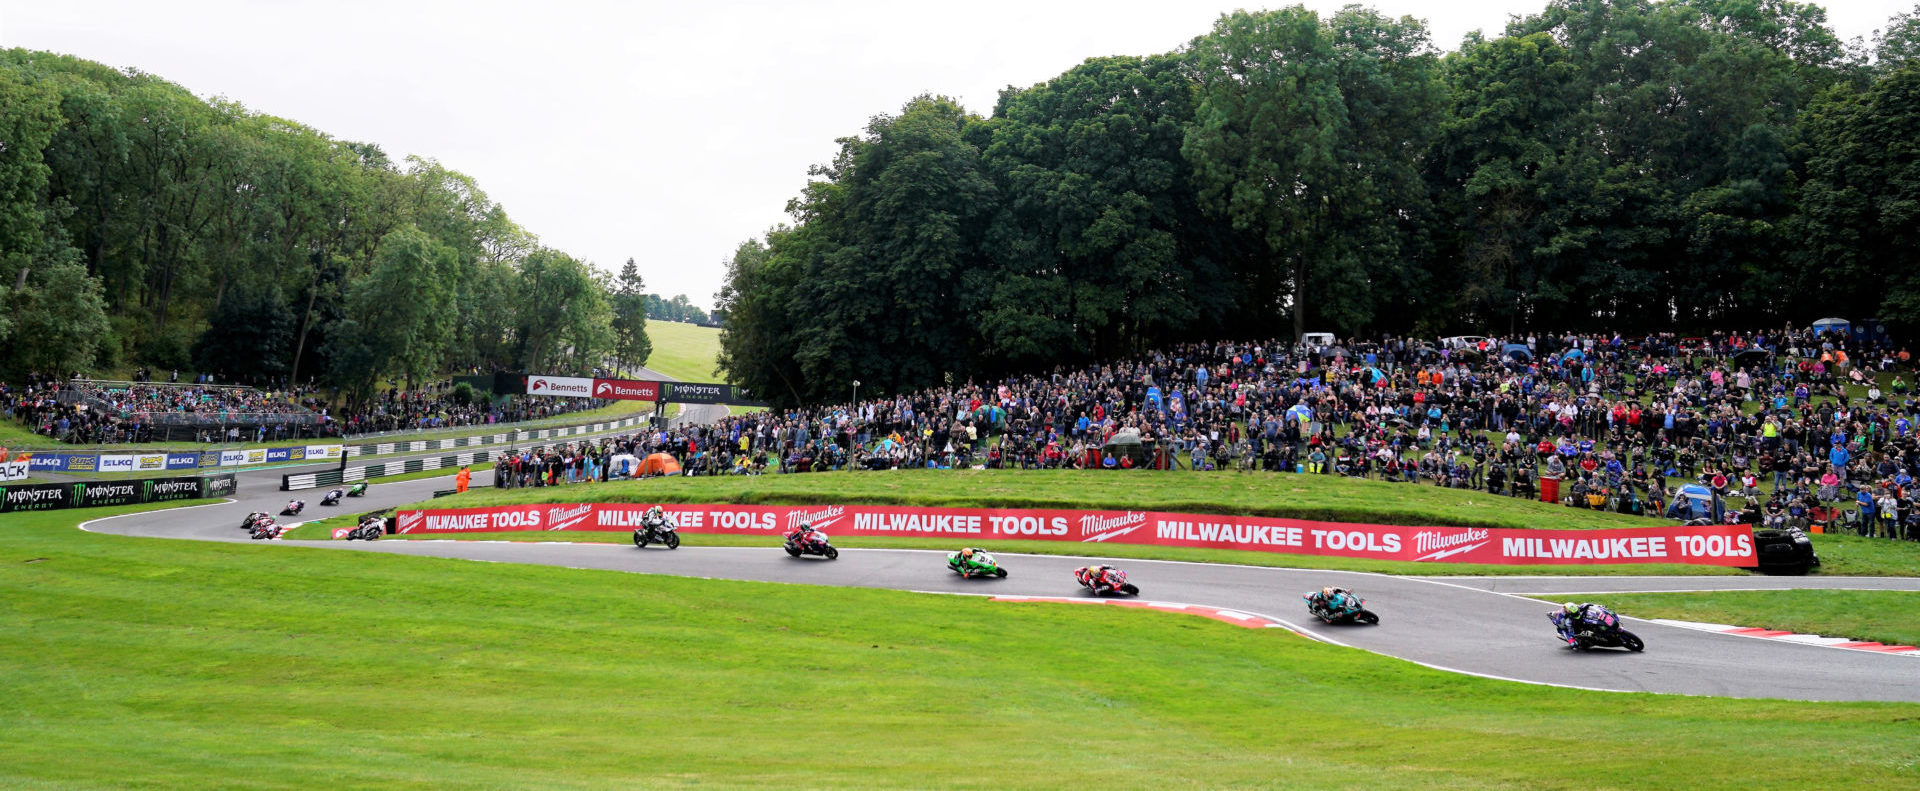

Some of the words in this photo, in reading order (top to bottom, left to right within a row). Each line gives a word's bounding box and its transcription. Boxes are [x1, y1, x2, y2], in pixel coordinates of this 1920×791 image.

[551, 383, 588, 393] Bennetts
[615, 386, 654, 396] Bennetts
[674, 385, 720, 395] MONSTER
[36, 458, 61, 466] LKQ
[7, 488, 62, 503] MONSTER
[86, 484, 135, 499] MONSTER
[154, 481, 198, 493] MONSTER
[14, 502, 54, 511] ENERGY
[548, 503, 593, 525] Milwaukee
[426, 513, 487, 530] MILWAUKEE
[492, 510, 541, 528] TOOLS
[597, 510, 703, 527] MILWKEE
[710, 511, 777, 529] TOOLS
[785, 505, 844, 530] Milwaukee
[854, 512, 981, 534] MILWAUKEE
[989, 516, 1069, 536] TOOLS
[1078, 510, 1146, 536] Milwaukee
[1157, 520, 1303, 547] MILWAUKEE
[1311, 529, 1401, 553] TOOLS
[1411, 527, 1489, 553] Milwaukee
[1502, 536, 1667, 559] MILWAUKEE
[1675, 534, 1752, 557] TOOLS
